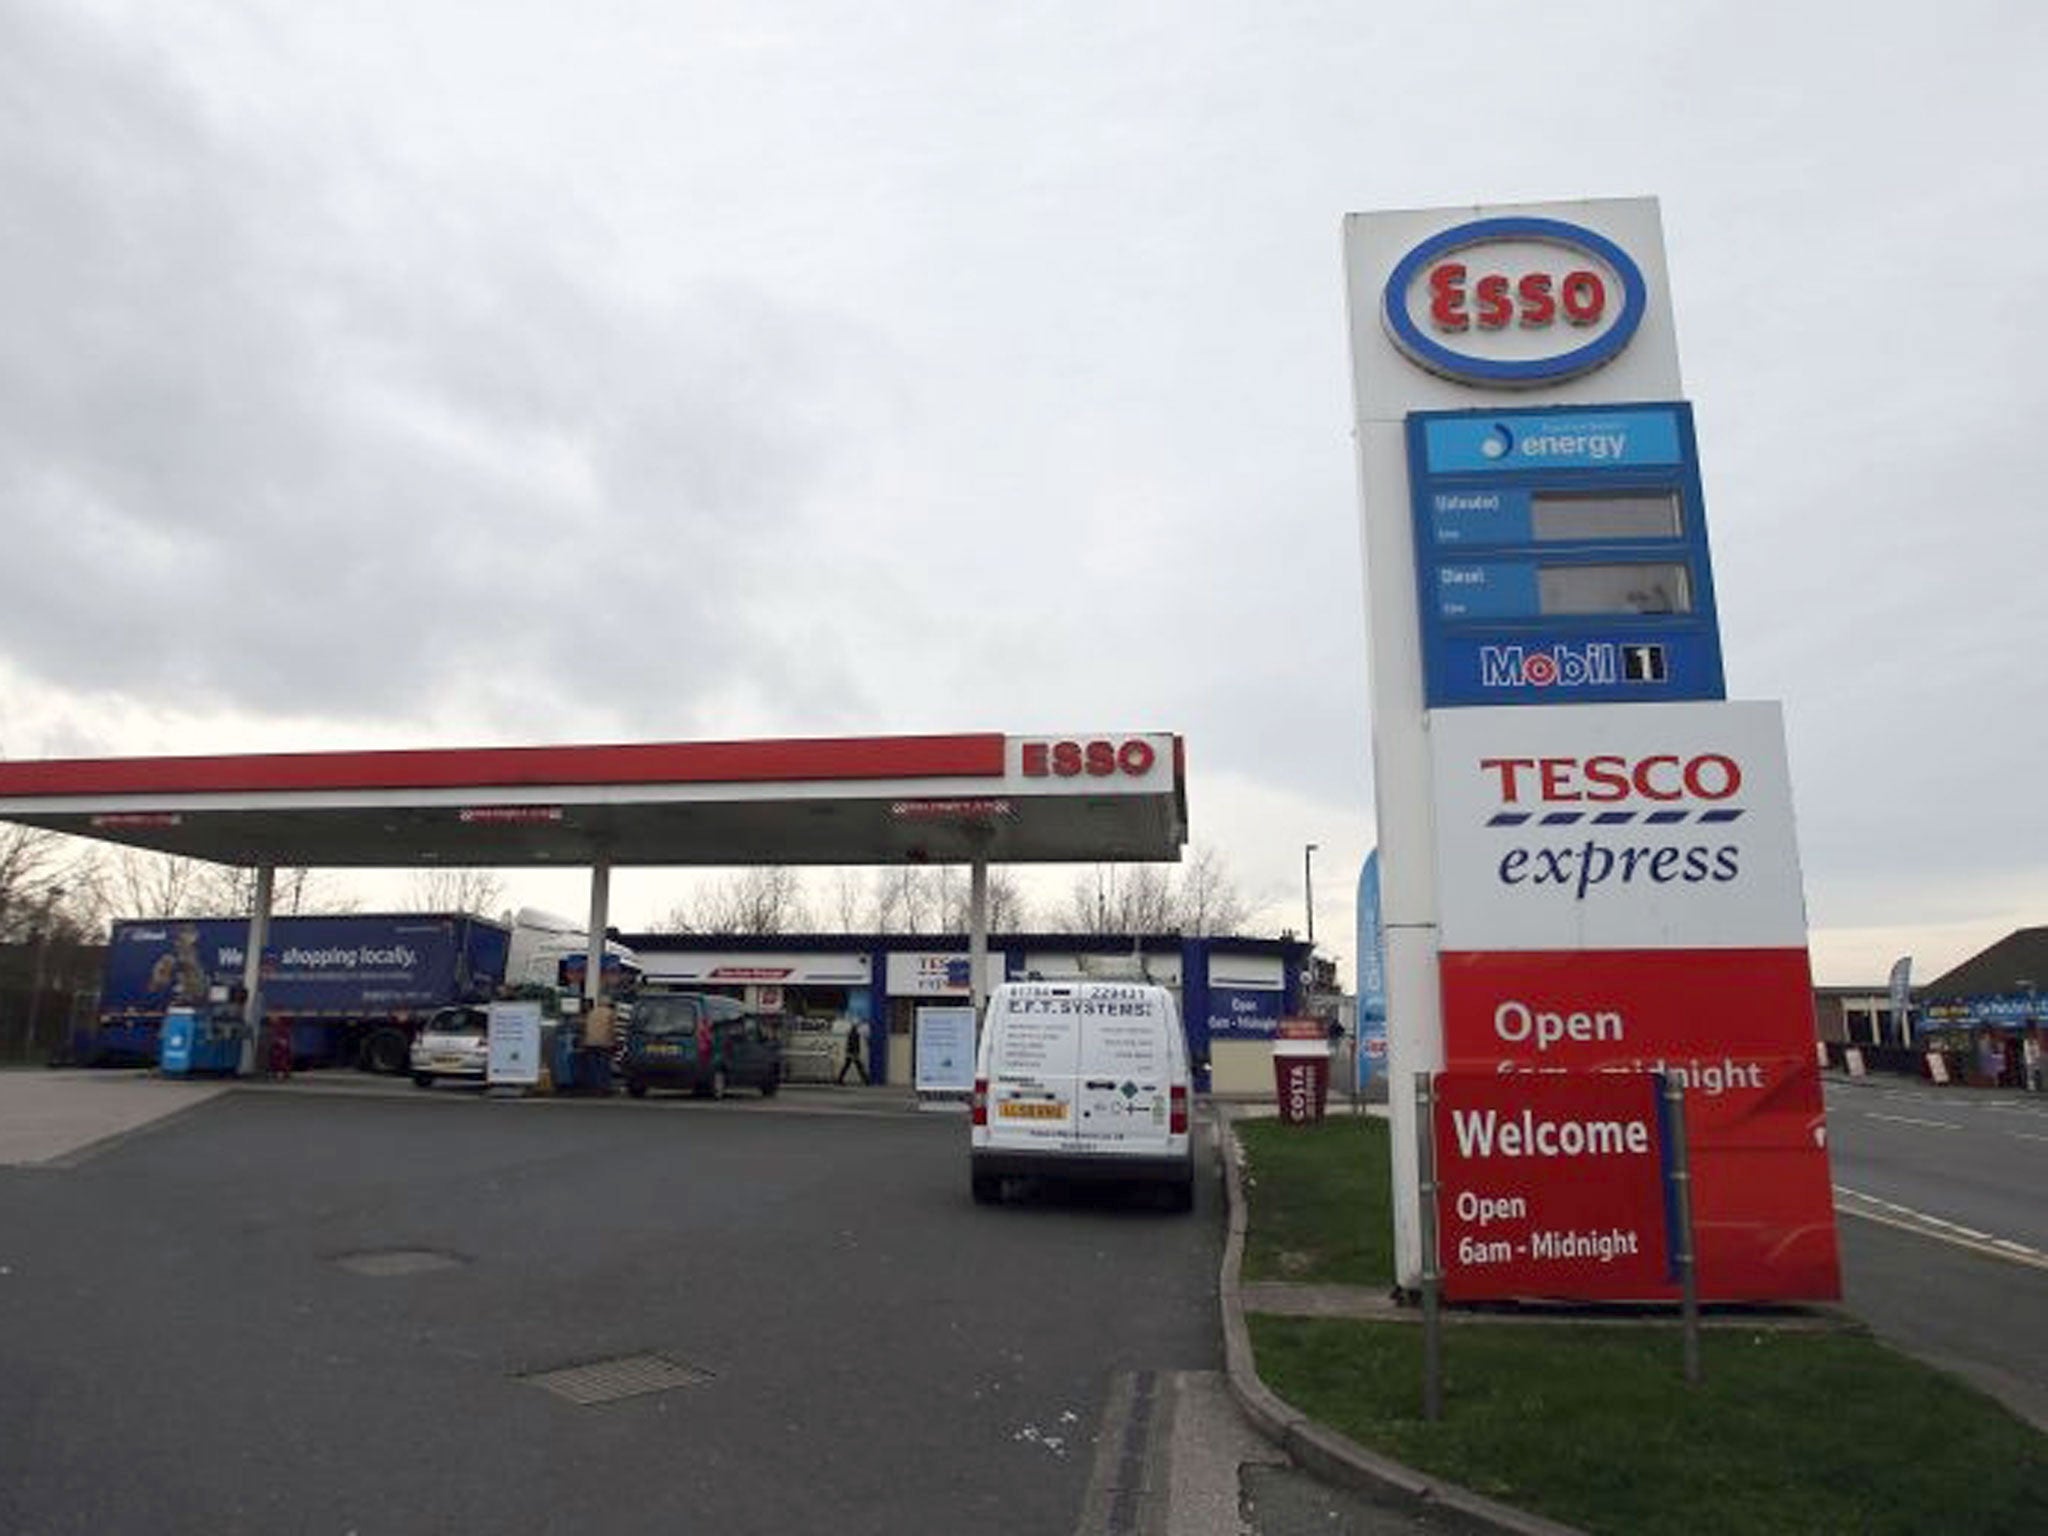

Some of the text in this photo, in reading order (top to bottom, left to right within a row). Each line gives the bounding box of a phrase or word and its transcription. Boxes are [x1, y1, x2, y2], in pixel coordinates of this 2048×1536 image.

[1522, 433, 1627, 458] energy
[1480, 644, 1616, 686] Mobil
[1022, 740, 1155, 777] ESSO
[1480, 754, 1742, 803] TESCO
[1498, 840, 1739, 900] express
[282, 946, 357, 967] shopping
[1494, 1000, 1624, 1049] Open
[1453, 1109, 1649, 1158] Welcome
[1457, 1191, 1526, 1226] Open
[1459, 1236, 1511, 1264] 6am
[1532, 1229, 1638, 1262] Midnight
